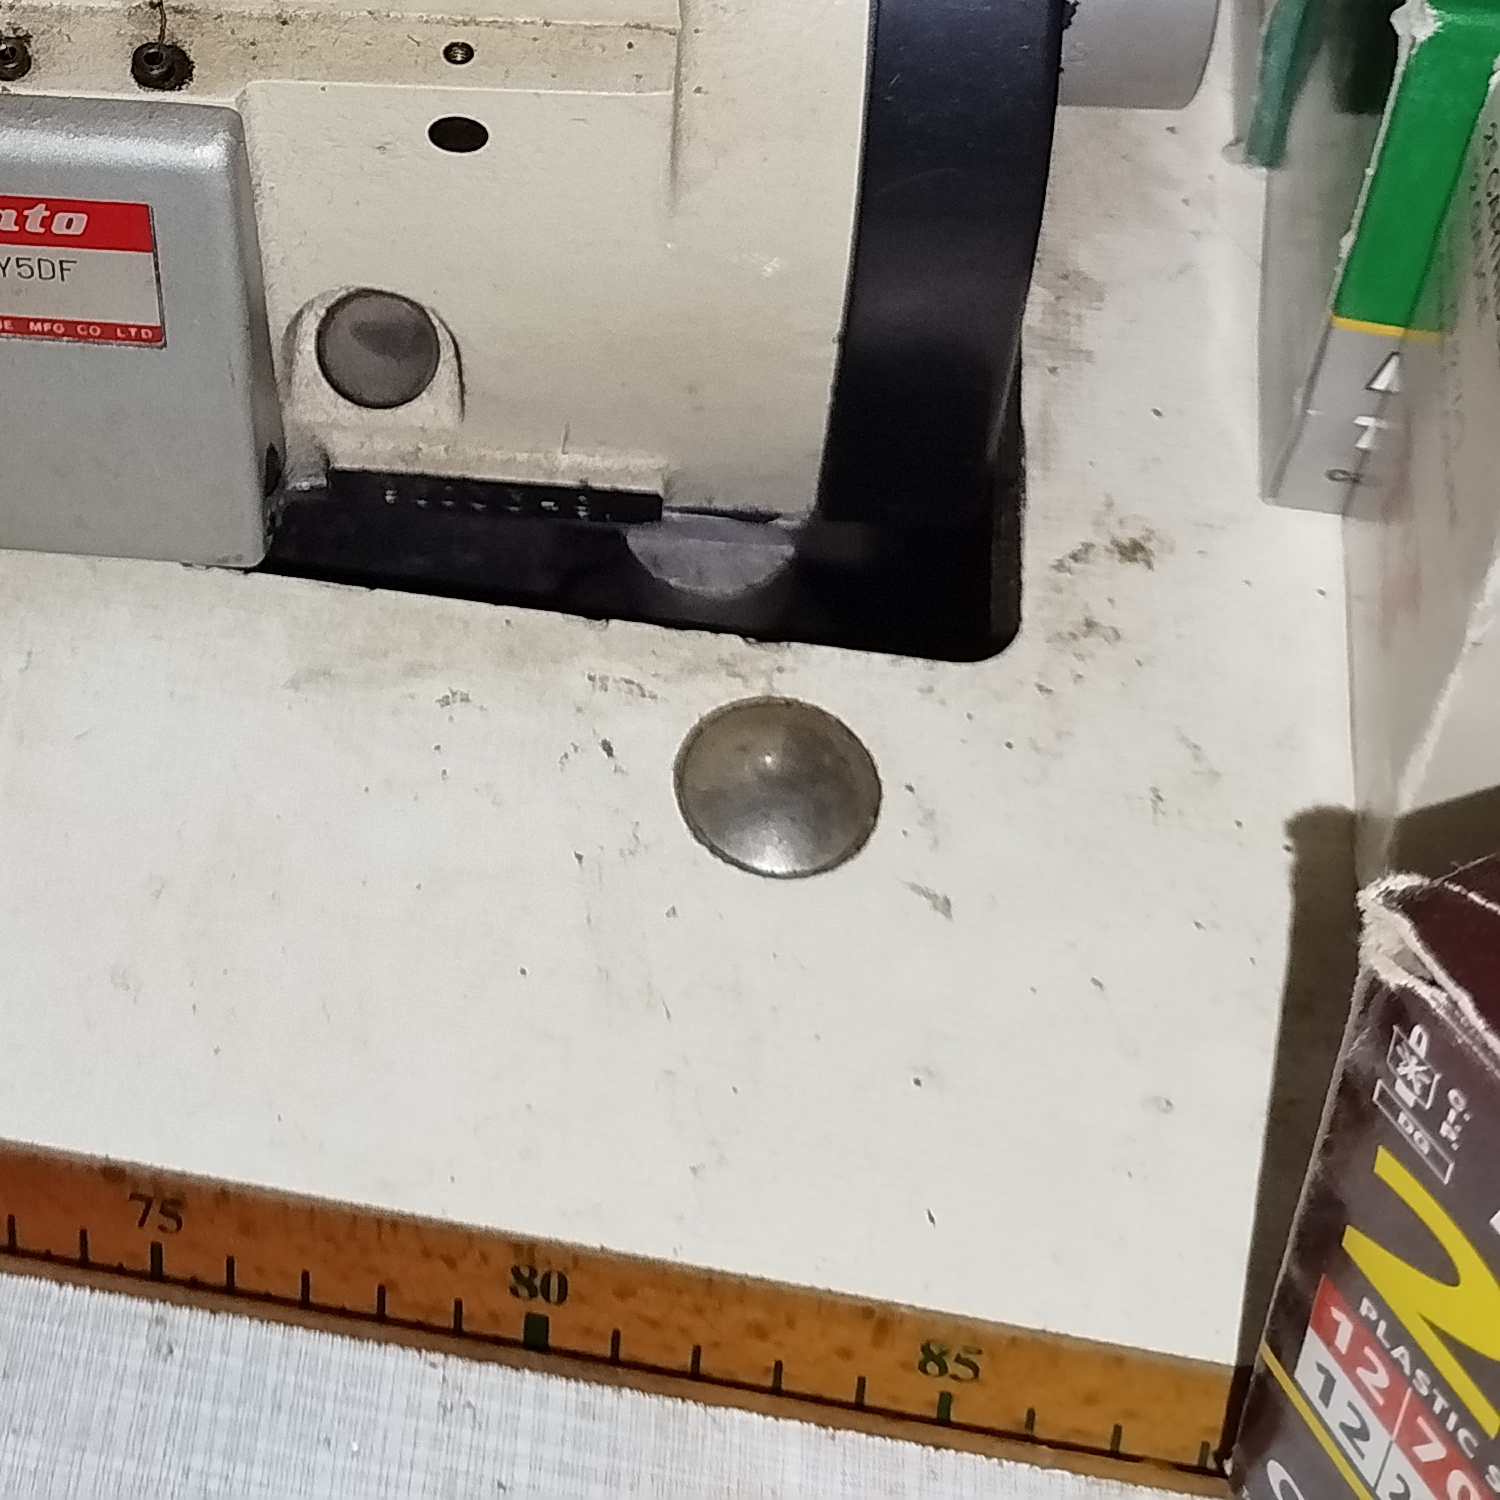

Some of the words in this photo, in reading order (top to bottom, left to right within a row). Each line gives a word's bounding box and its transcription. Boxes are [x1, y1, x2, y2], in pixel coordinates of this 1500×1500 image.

[29, 321, 66, 334] MFG
[76, 324, 102, 337] CO
[116, 326, 153, 339] LTD
[128, 1192, 187, 1234] 75
[508, 1264, 569, 1306] 80
[918, 1340, 983, 1382] 85
[1359, 1296, 1479, 1460] PLASTIC
